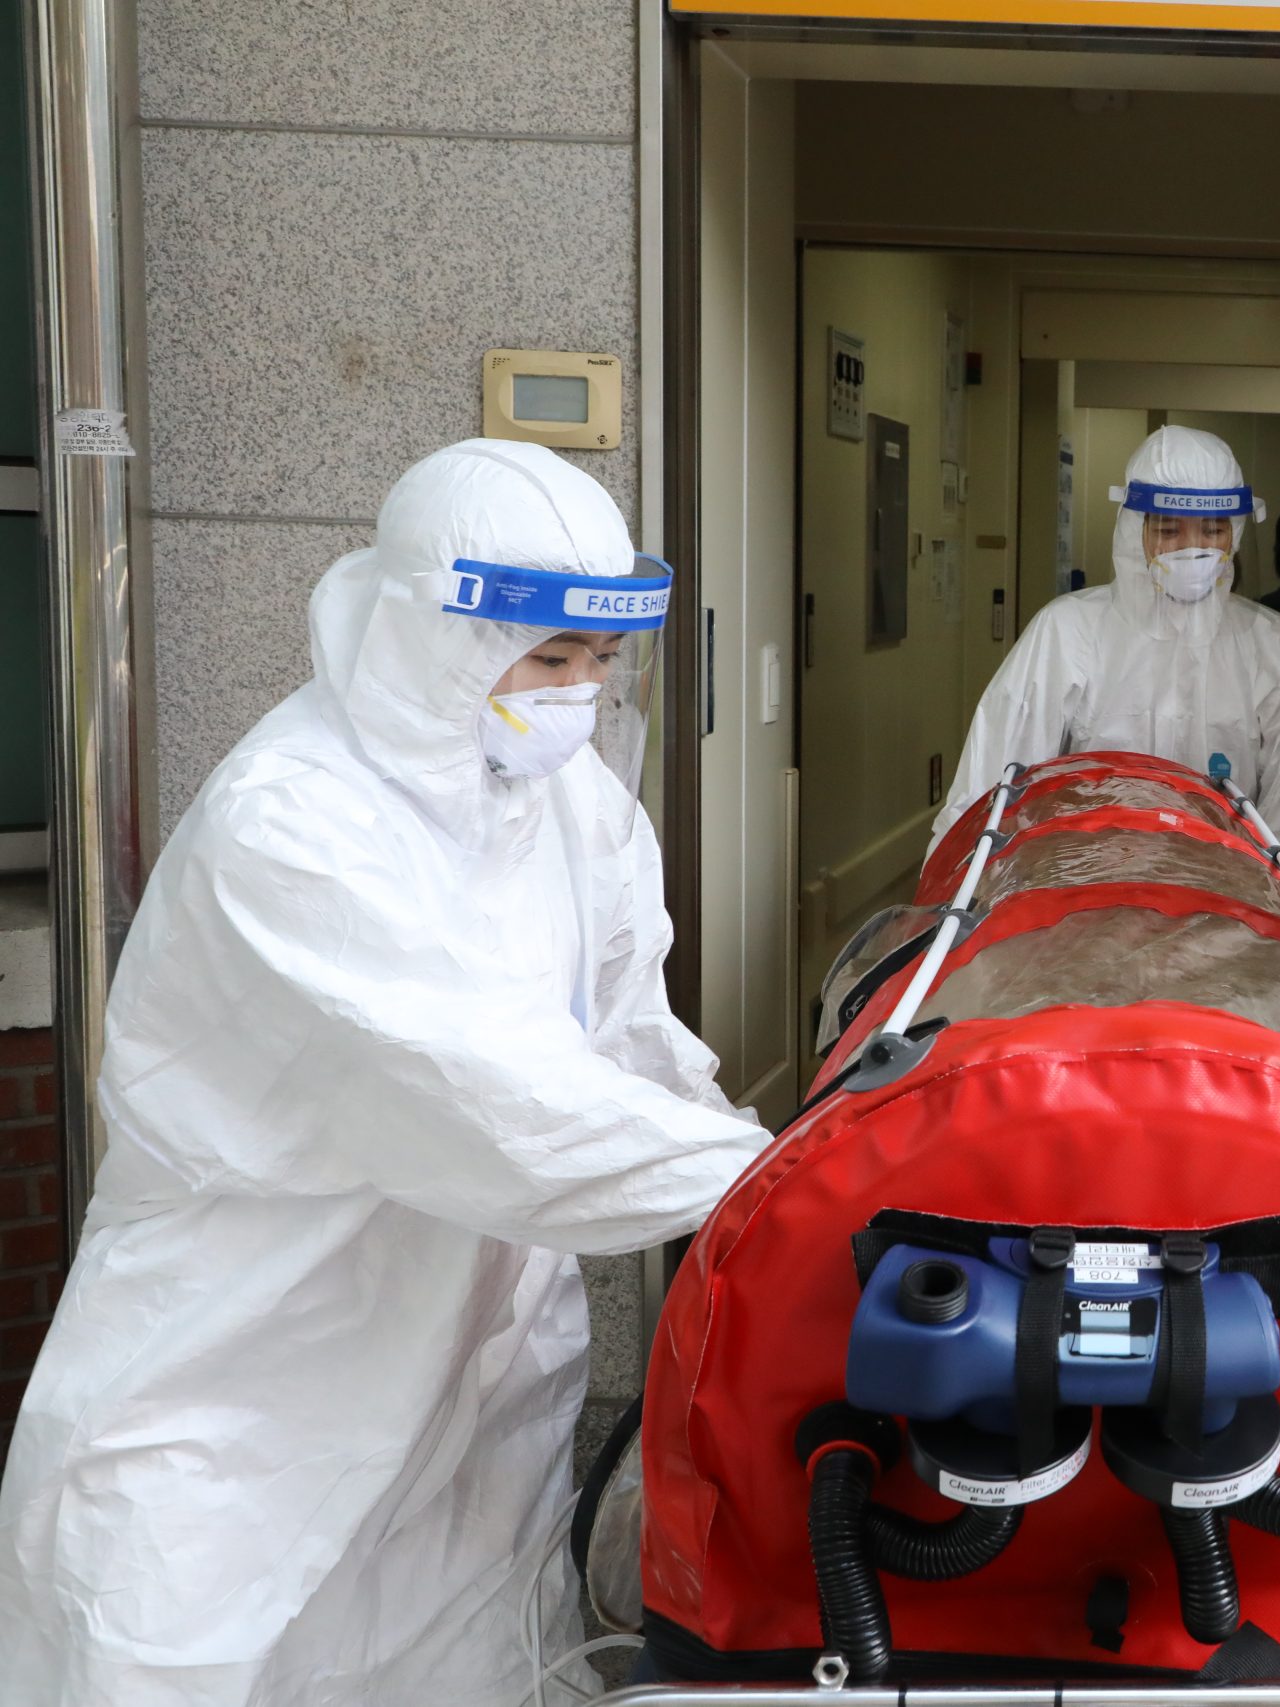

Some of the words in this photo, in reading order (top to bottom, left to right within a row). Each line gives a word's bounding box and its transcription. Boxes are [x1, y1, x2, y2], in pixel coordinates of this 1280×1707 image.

[1164, 496, 1192, 507] FACE
[1196, 497, 1233, 508] SHIELD
[587, 595, 636, 613] FACE
[1089, 1270, 1123, 1281] 708
[1079, 1300, 1130, 1311] CleanAIR
[949, 1478, 1006, 1495] CleanAIR
[1183, 1482, 1240, 1498] CleanAIR
